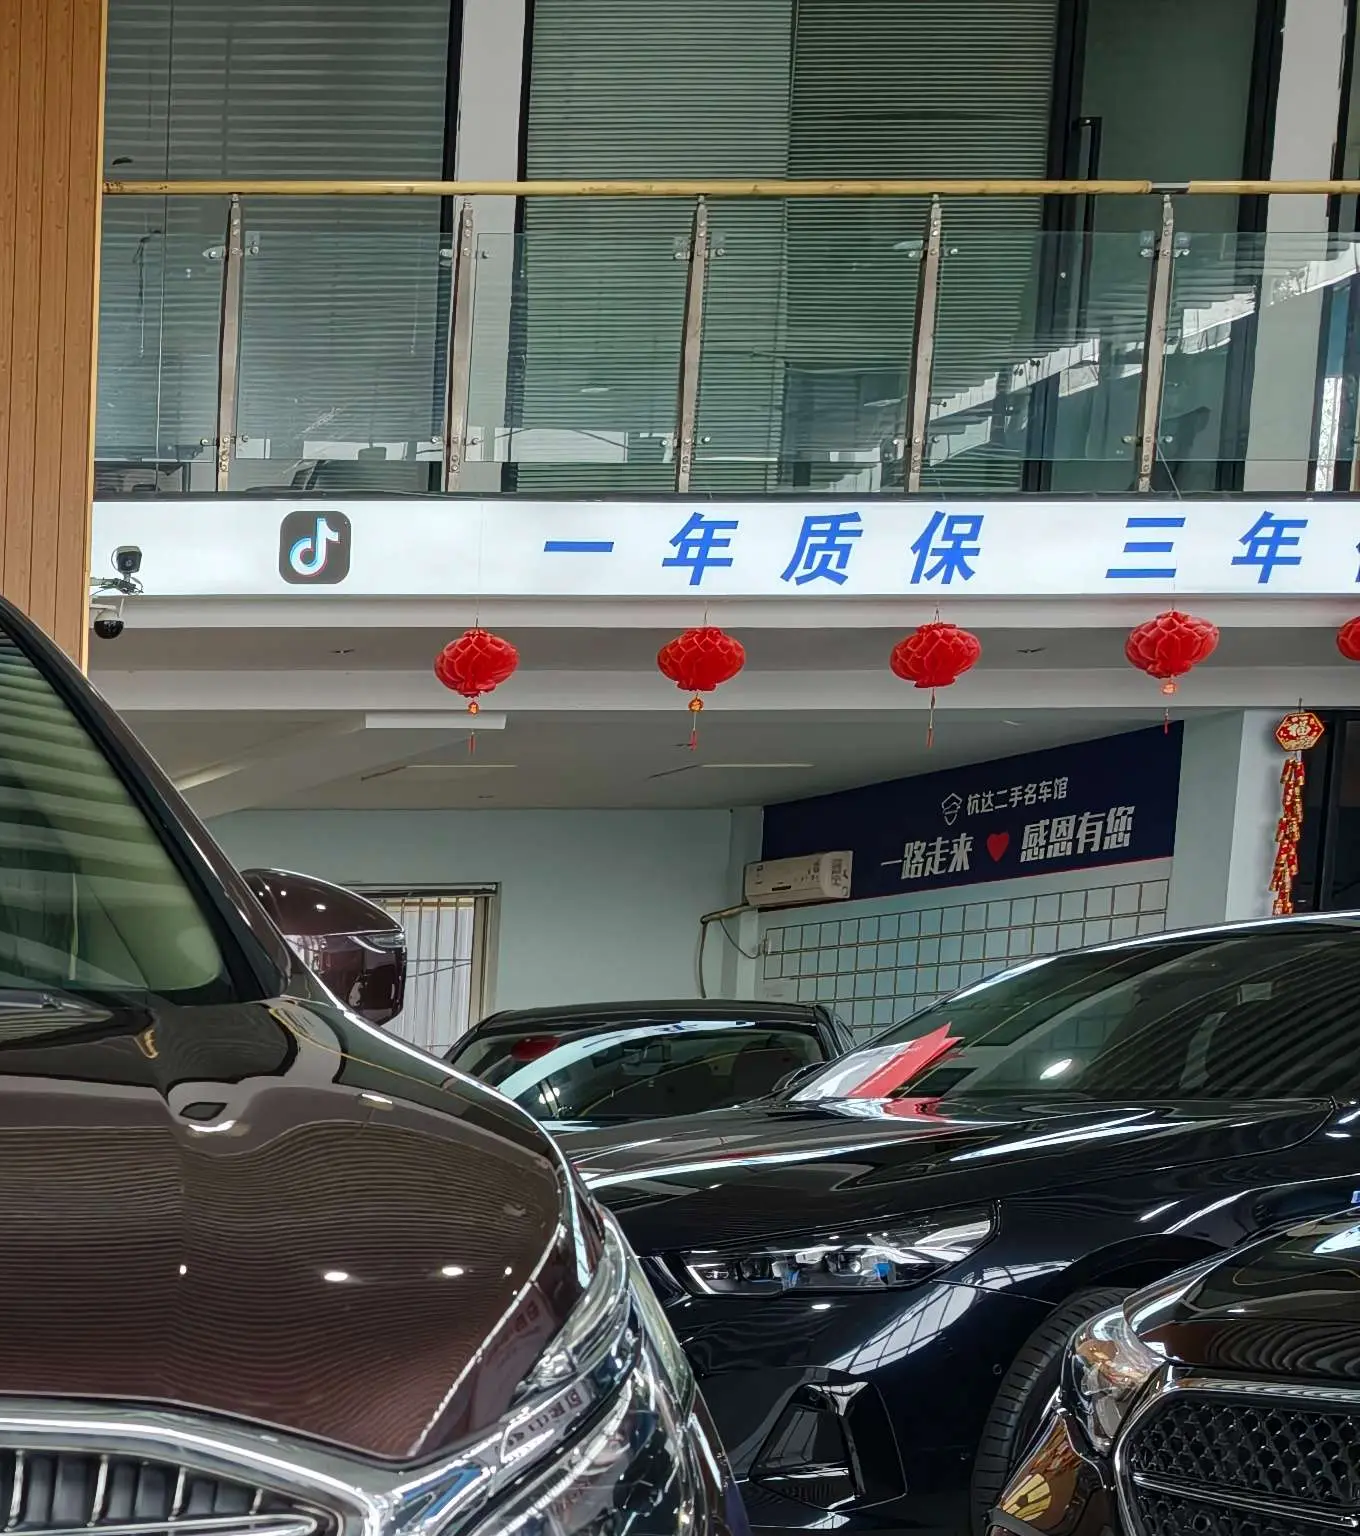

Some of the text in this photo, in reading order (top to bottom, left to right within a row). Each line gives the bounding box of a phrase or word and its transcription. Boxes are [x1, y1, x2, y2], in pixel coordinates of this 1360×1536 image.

[543, 511, 1360, 586] 一年质保 三年
[966, 776, 1070, 816] 杭达二手名车馆
[880, 832, 974, 880] 一路走来
[1019, 805, 1136, 863] 感恩有您
